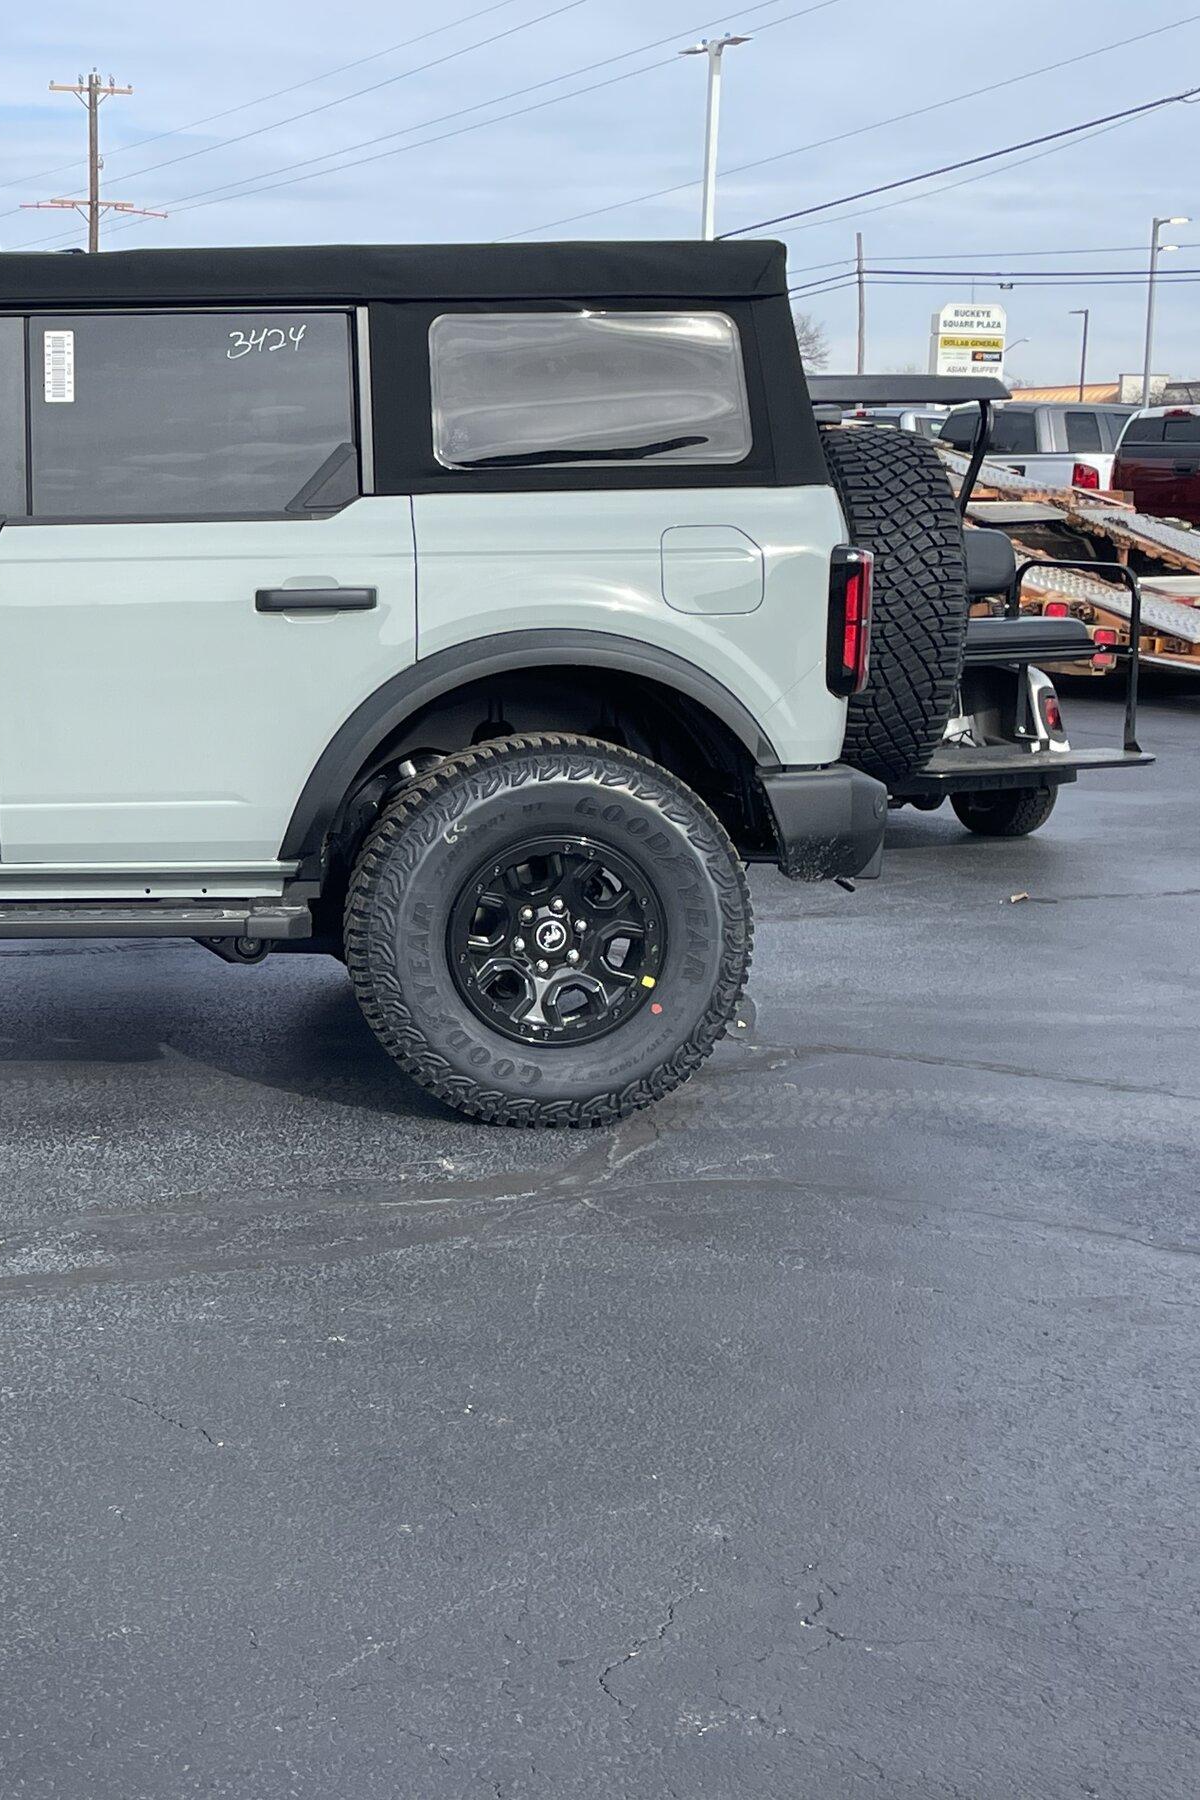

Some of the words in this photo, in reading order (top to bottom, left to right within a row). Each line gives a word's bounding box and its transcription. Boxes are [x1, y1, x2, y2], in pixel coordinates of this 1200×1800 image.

[954, 309, 991, 318] BUCKEYE
[942, 320, 974, 328] SQUARE
[976, 320, 1001, 329] PLAZA
[227, 325, 306, 359] 3424
[943, 339, 969, 347] DOLLAR
[970, 339, 1000, 347] GENERAL
[971, 366, 999, 374] BUFFET
